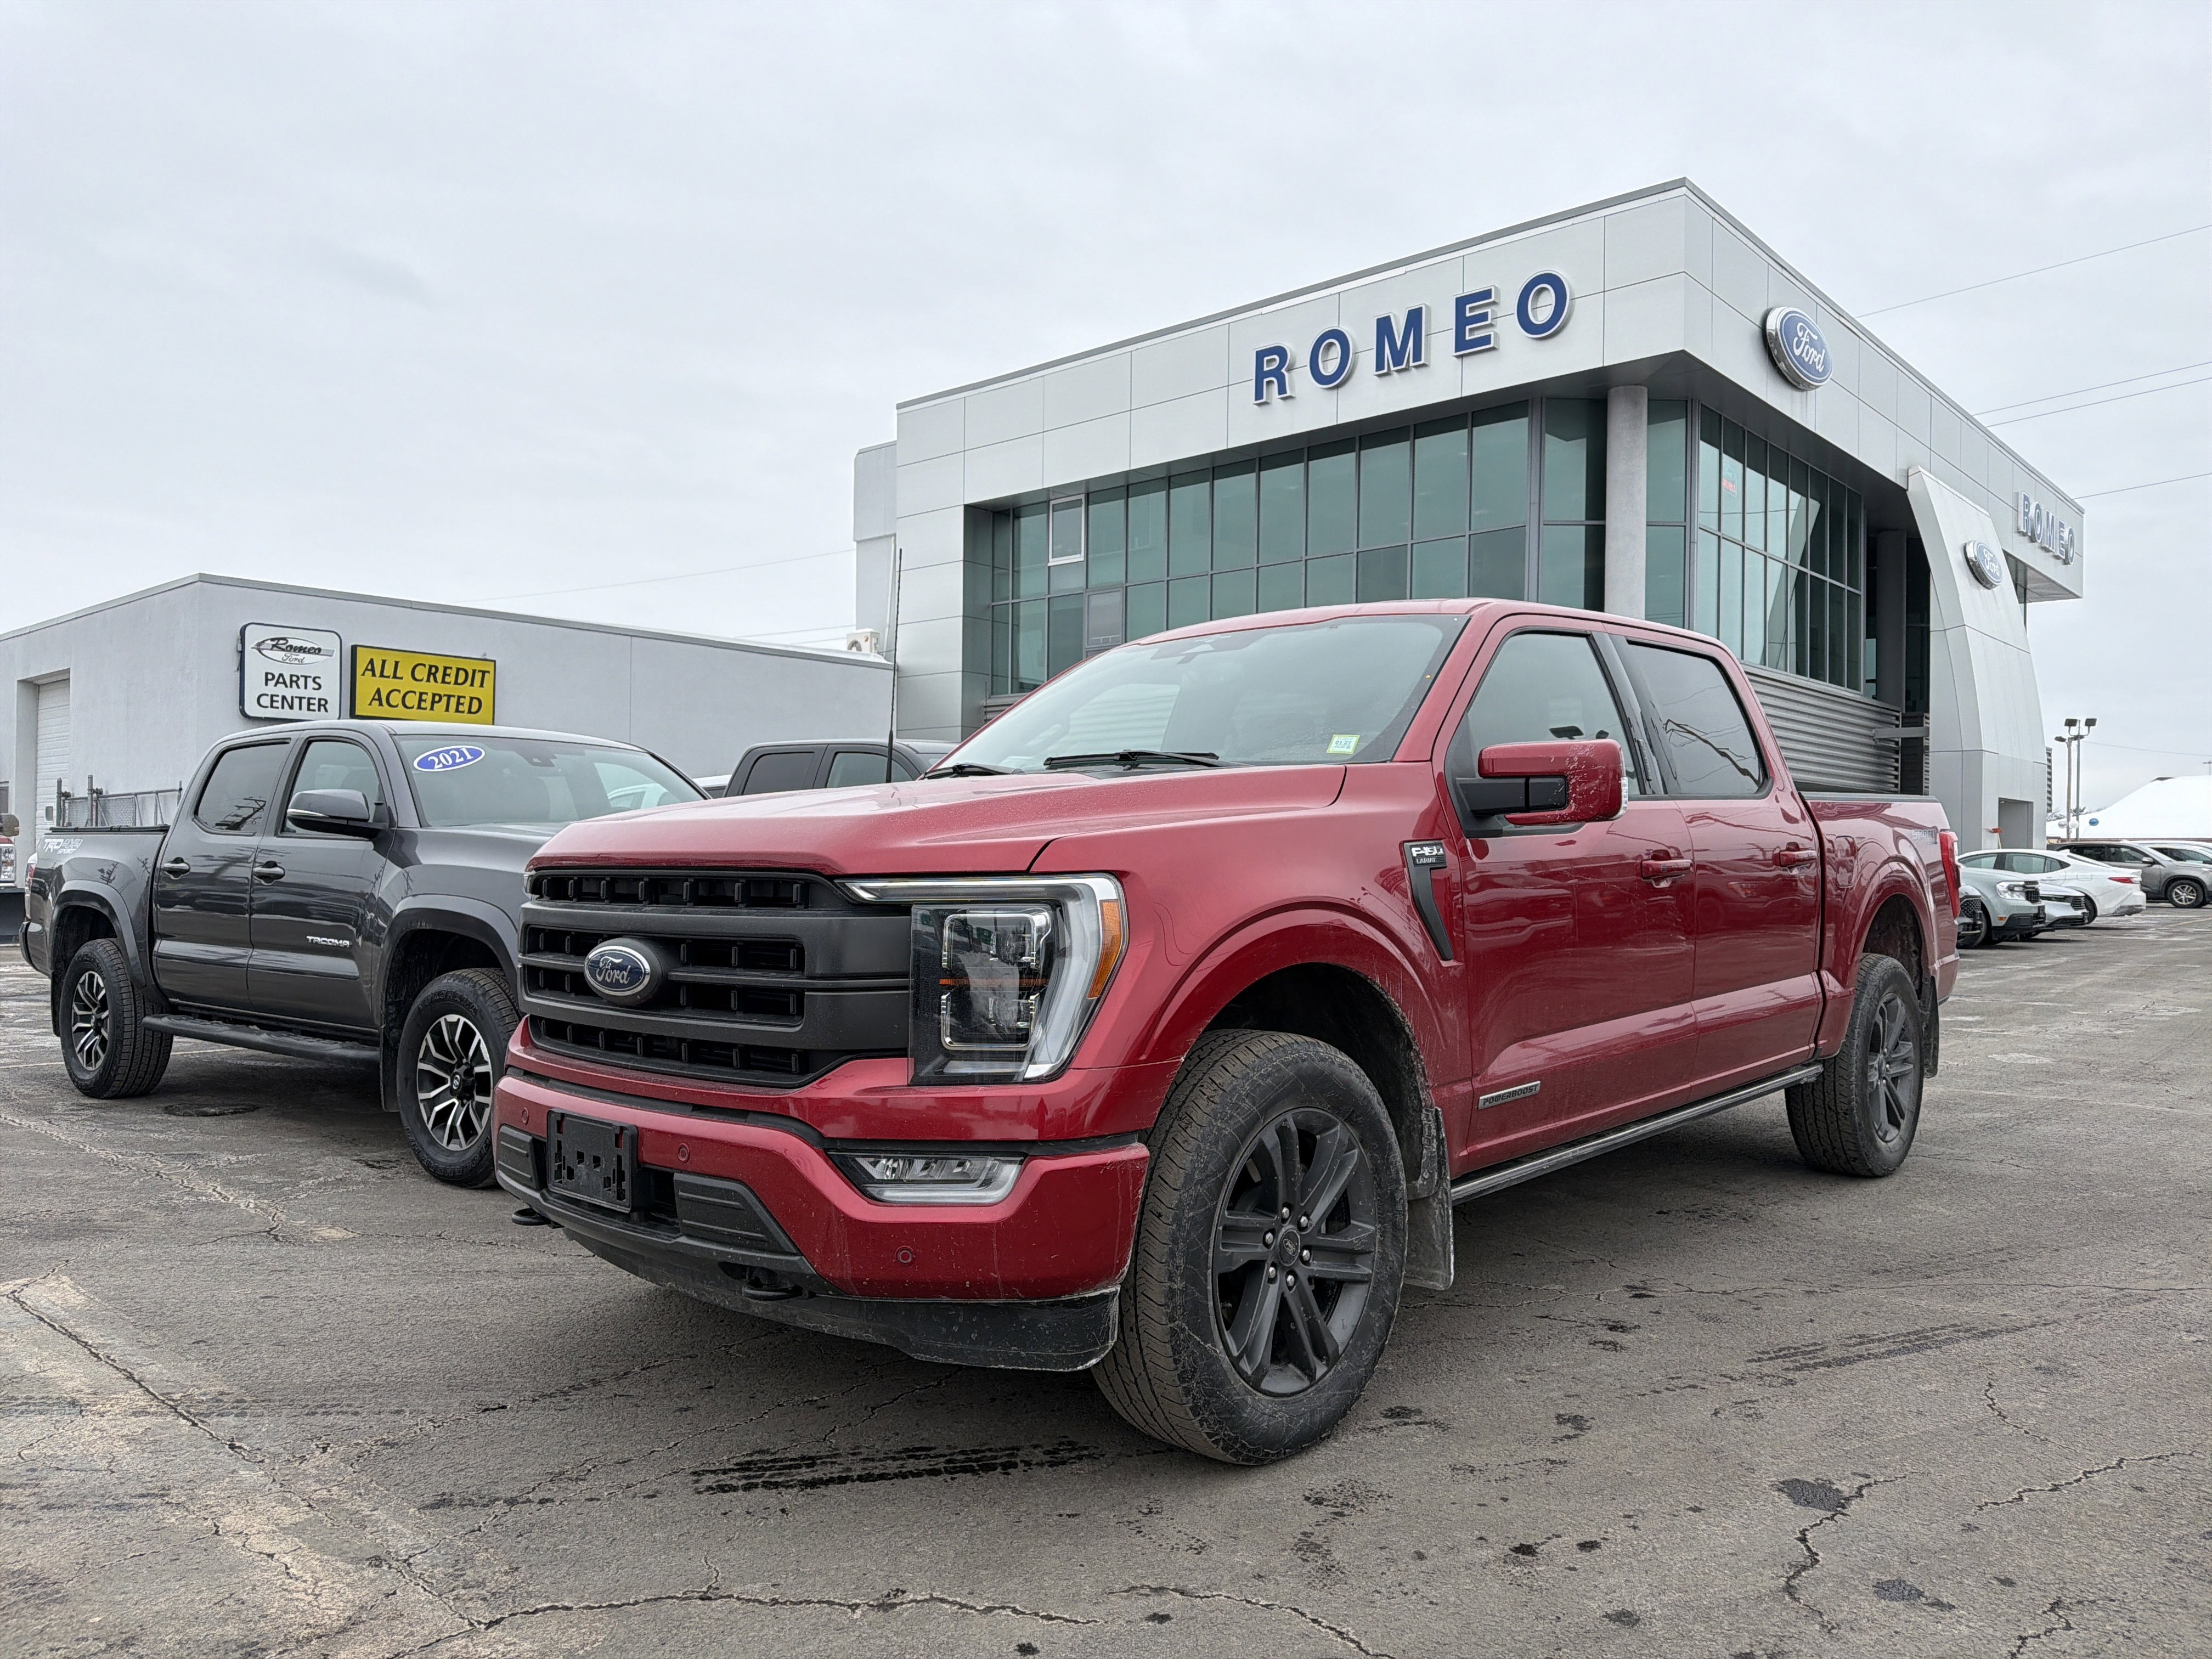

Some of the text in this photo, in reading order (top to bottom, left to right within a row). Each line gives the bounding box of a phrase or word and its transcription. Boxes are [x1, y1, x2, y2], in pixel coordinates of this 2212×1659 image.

[1253, 269, 1572, 405] ROMEO
[1793, 322, 1826, 373] Ford
[2019, 492, 2075, 565] ROMEO
[1983, 549, 2000, 576] Ford
[269, 637, 322, 654] Romeo
[281, 653, 305, 663] Ford
[264, 672, 322, 691] PARTS
[361, 658, 490, 689] ALL CREDIT
[256, 693, 329, 713] CENTER
[368, 687, 483, 715] ACCEPTED
[428, 747, 474, 769] 2021
[43, 838, 64, 853] TRD
[306, 935, 350, 948] TACOMA
[596, 956, 631, 984] Ford
[1482, 1085, 1539, 1106] POWERBOOST
